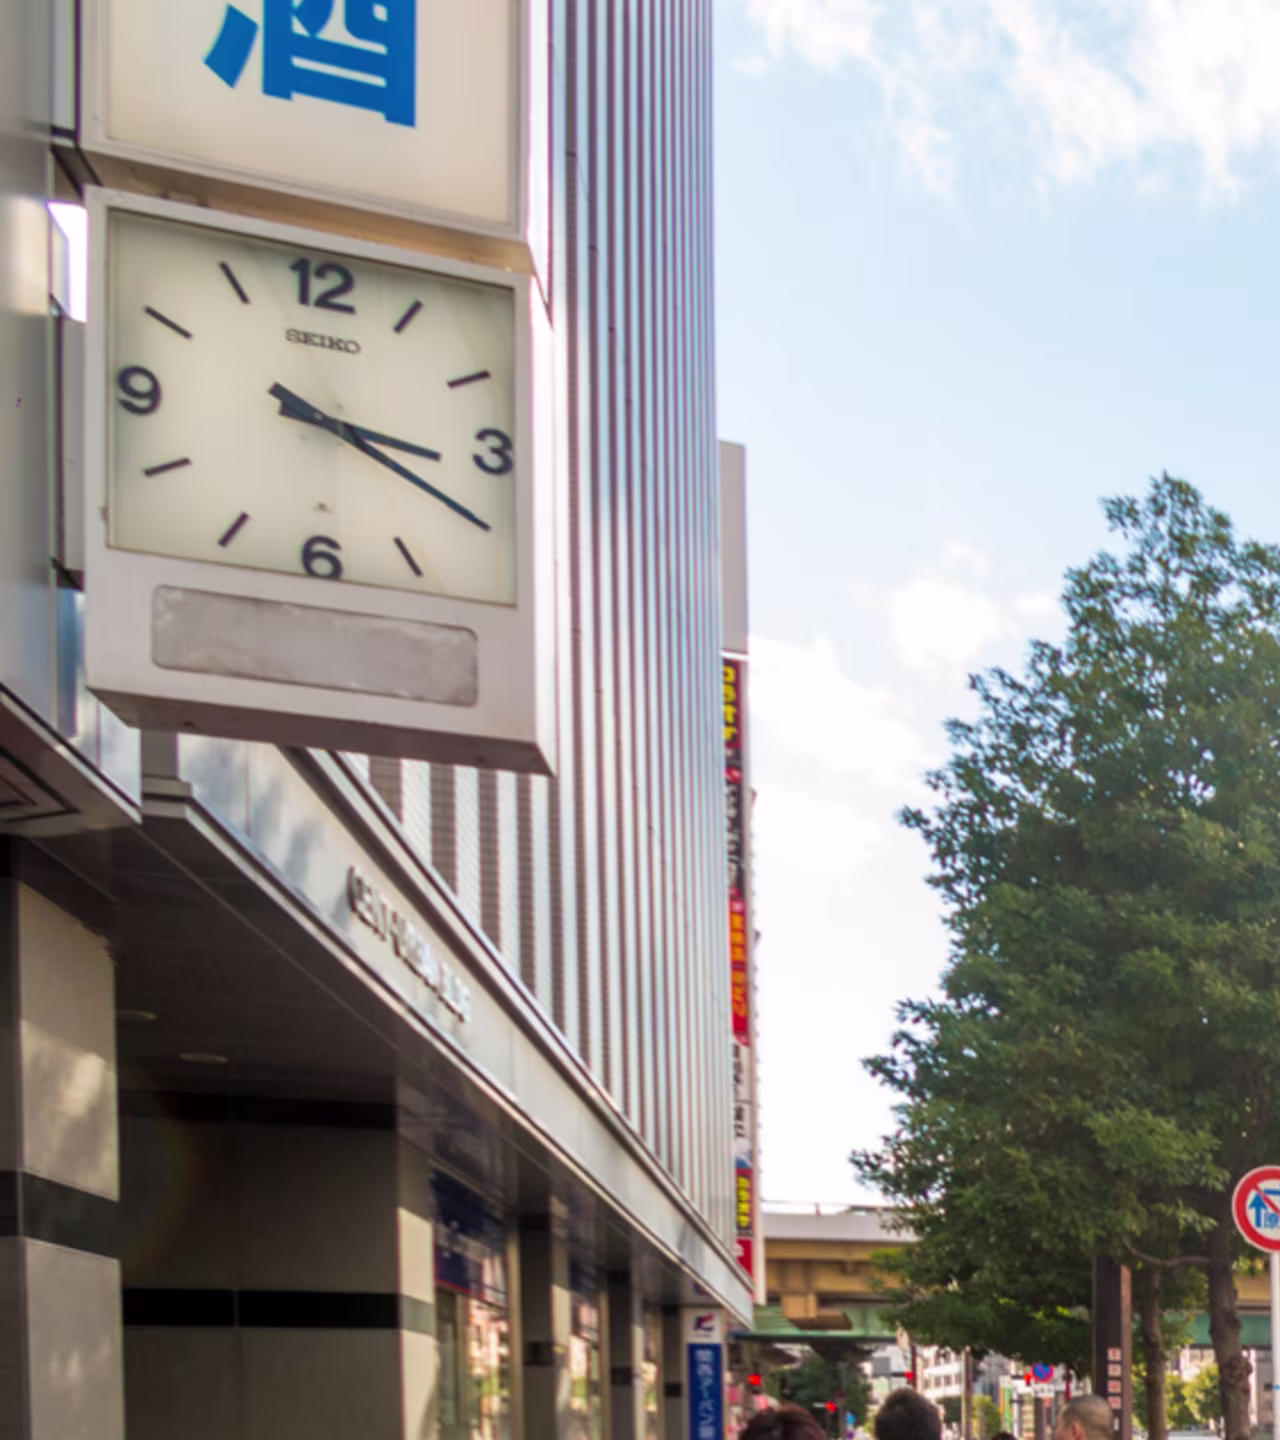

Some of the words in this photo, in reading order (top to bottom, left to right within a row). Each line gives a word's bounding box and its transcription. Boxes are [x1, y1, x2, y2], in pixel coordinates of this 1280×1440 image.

[289, 257, 357, 315] 12
[284, 327, 362, 355] SEIKO
[116, 366, 162, 416] 9
[471, 428, 516, 477] 3
[300, 534, 344, 581] 6
